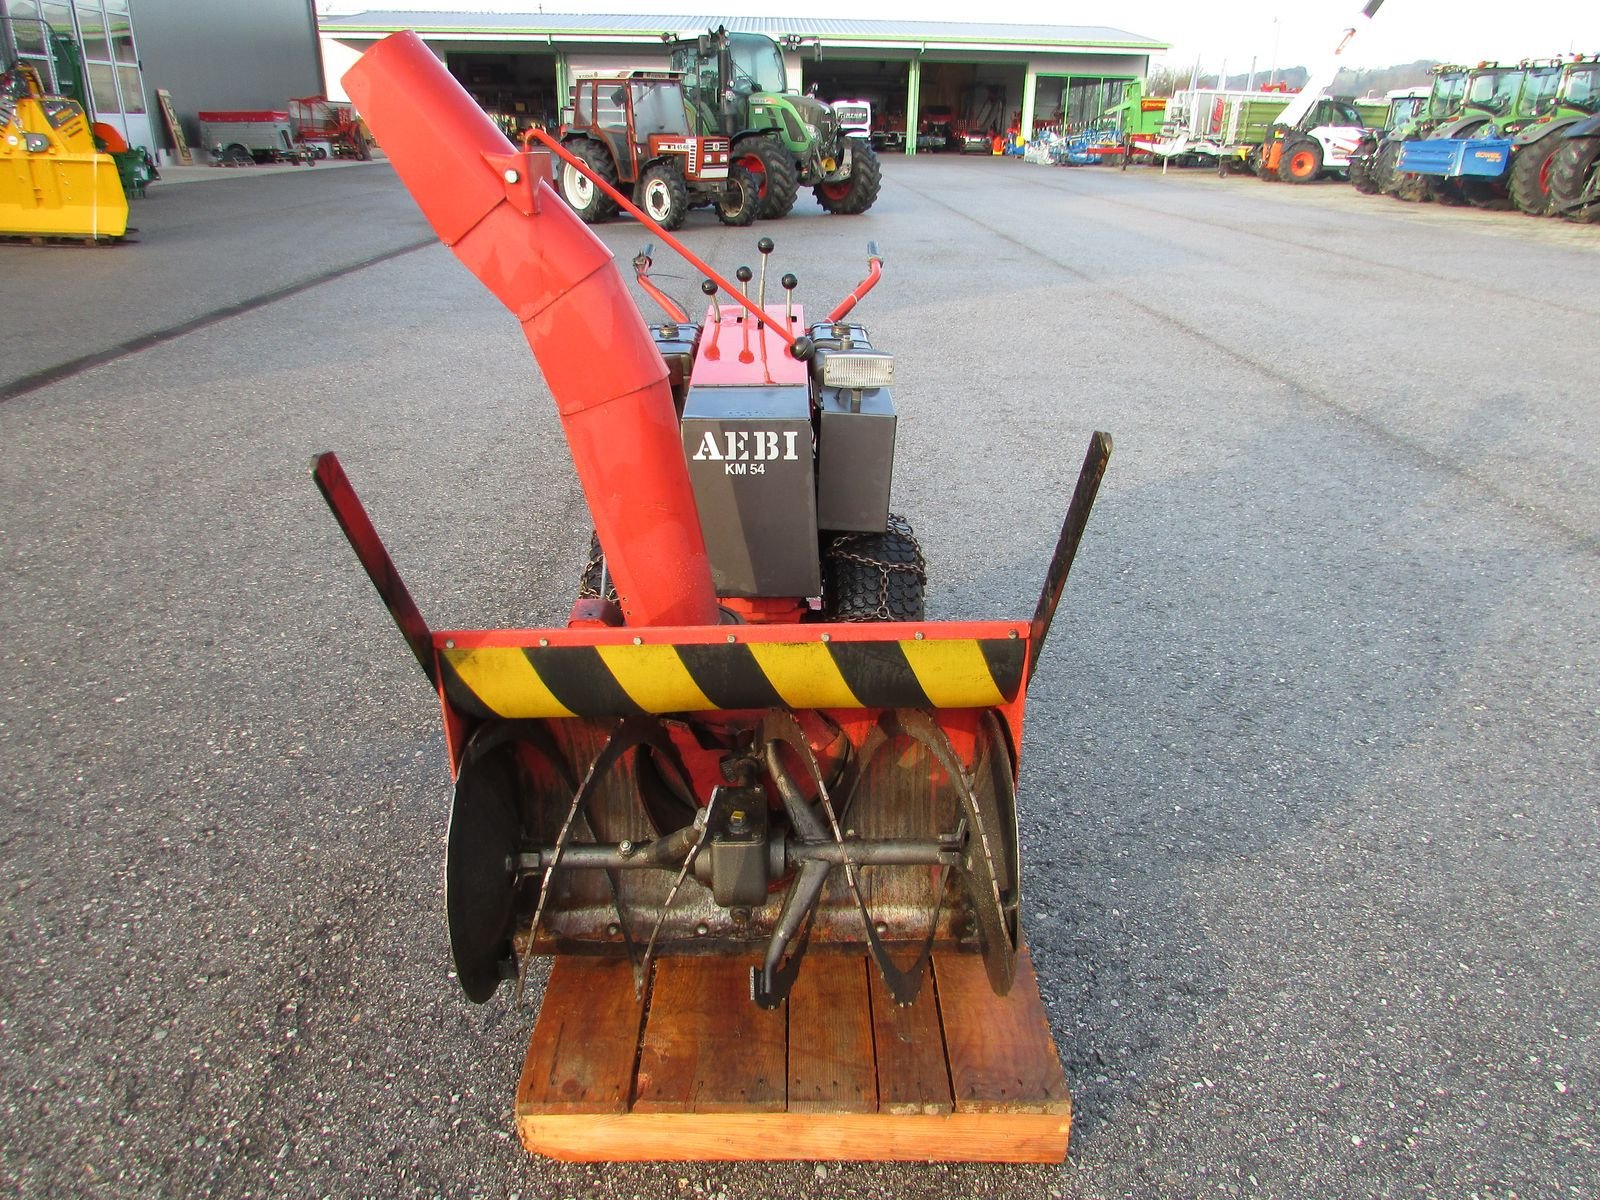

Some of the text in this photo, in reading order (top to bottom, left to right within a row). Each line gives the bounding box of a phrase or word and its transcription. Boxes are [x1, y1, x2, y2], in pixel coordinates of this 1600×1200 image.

[692, 431, 799, 461] AEBI
[725, 463, 766, 475] KM 54
